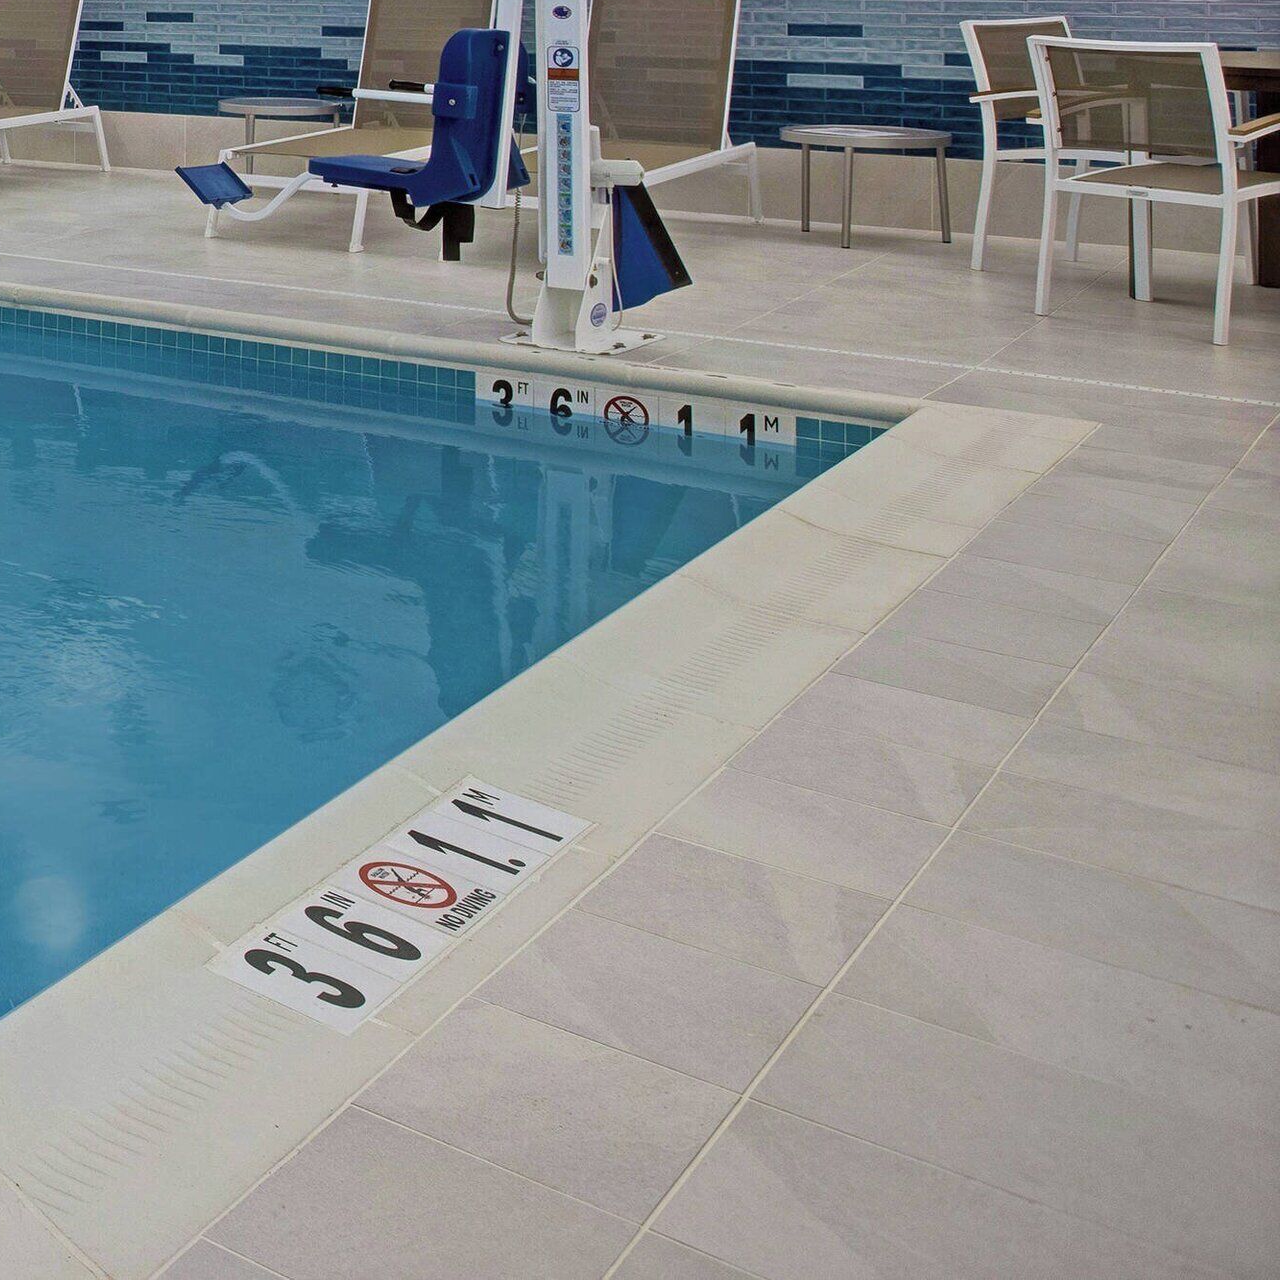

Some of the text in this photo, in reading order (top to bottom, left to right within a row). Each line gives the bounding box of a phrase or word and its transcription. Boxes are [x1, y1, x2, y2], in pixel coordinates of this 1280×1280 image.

[492, 379, 778, 446] 3 FT 6 IN 1 1 M
[462, 787, 501, 806] M
[451, 799, 564, 843] 1
[320, 891, 356, 910] IN
[435, 887, 497, 931] NO DIVING
[263, 932, 298, 952] FT
[304, 905, 422, 961] 6
[244, 948, 366, 1009] 3
